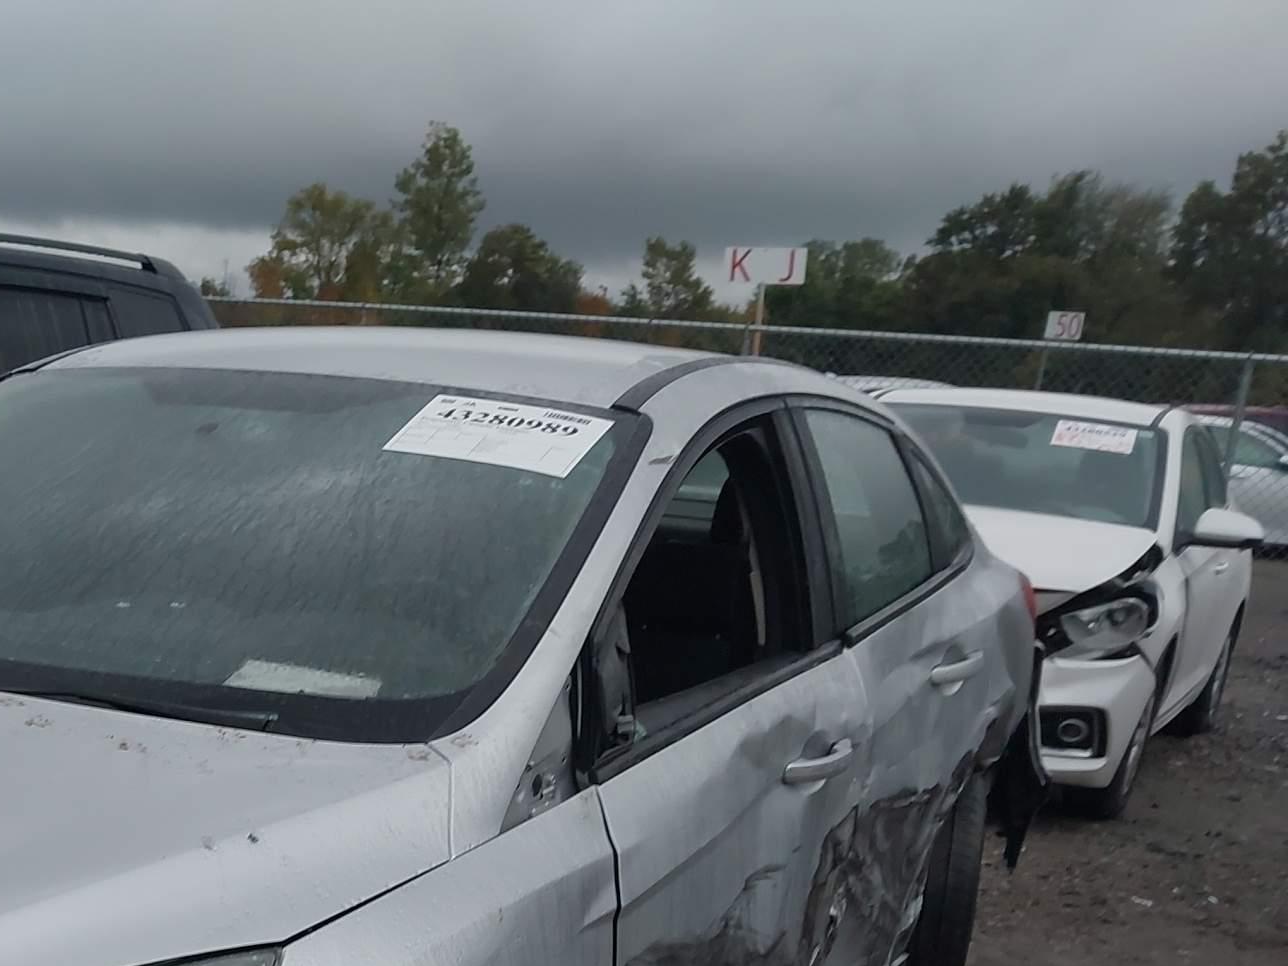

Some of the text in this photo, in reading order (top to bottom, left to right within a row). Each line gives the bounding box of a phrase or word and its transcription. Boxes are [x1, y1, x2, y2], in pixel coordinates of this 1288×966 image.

[729, 248, 795, 282] K J
[1055, 313, 1081, 337] 50
[437, 408, 580, 437] 43280989
